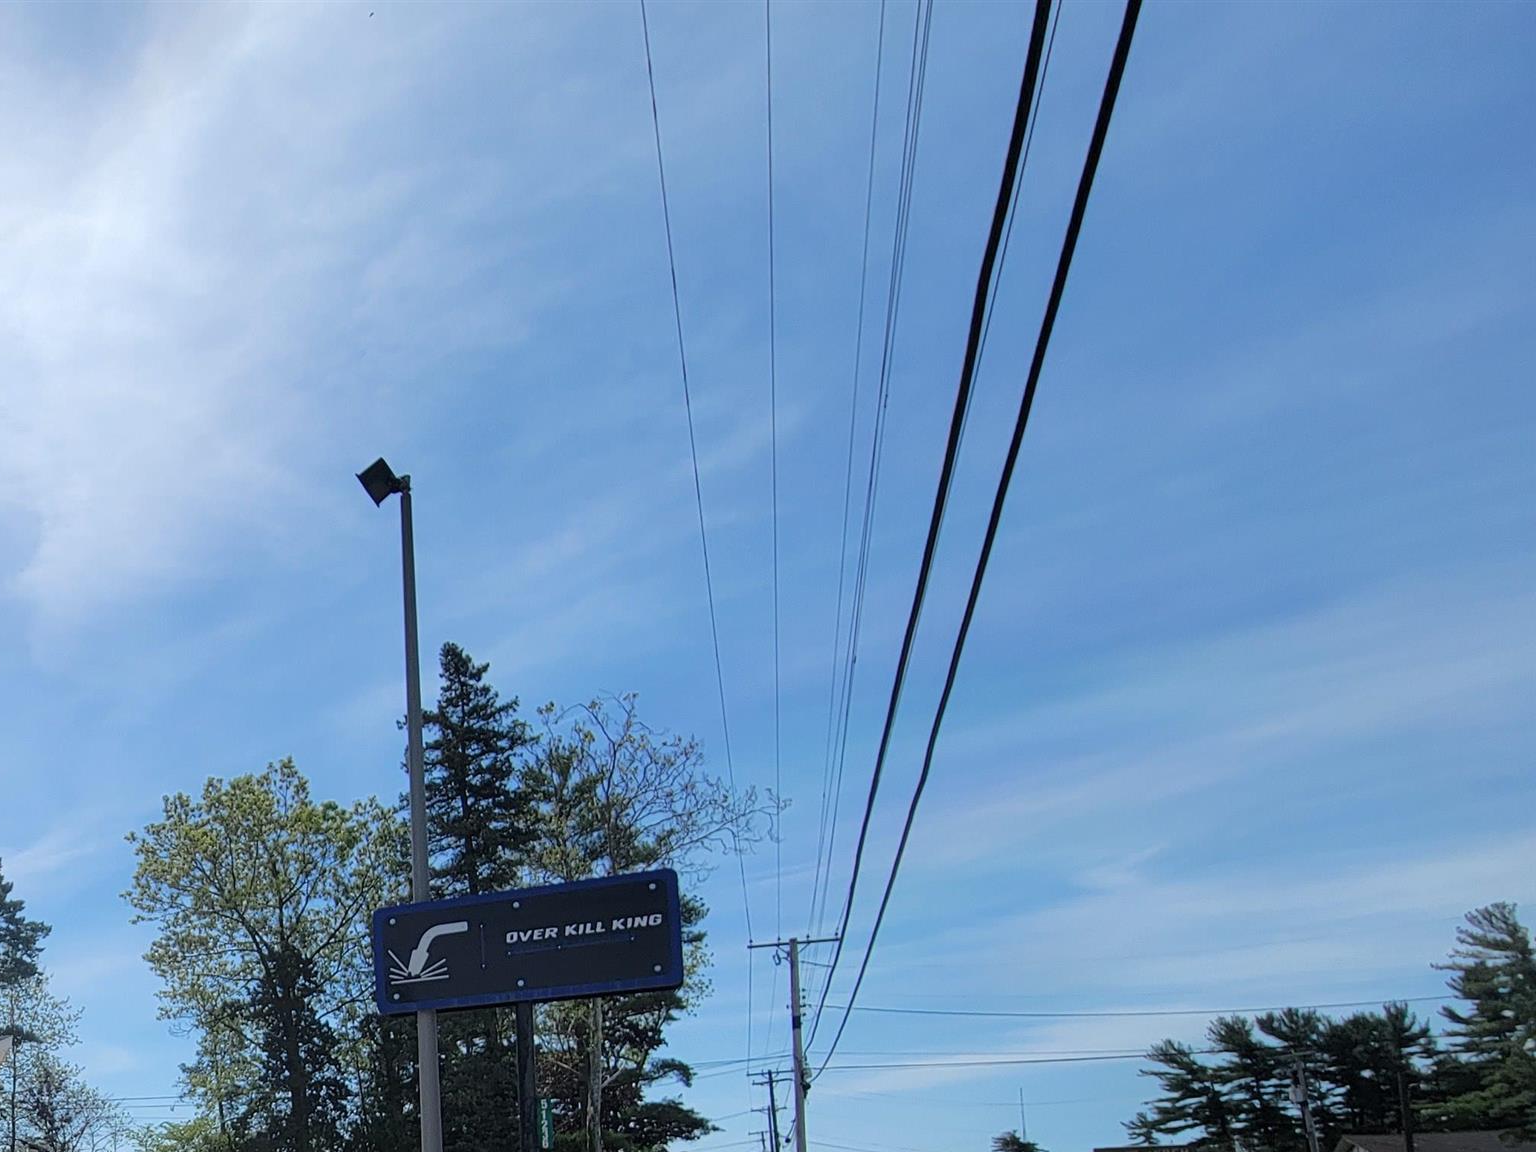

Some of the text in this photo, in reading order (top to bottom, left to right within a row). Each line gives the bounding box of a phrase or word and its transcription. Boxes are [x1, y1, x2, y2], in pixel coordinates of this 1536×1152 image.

[506, 913, 663, 944] OVER KILL KING
